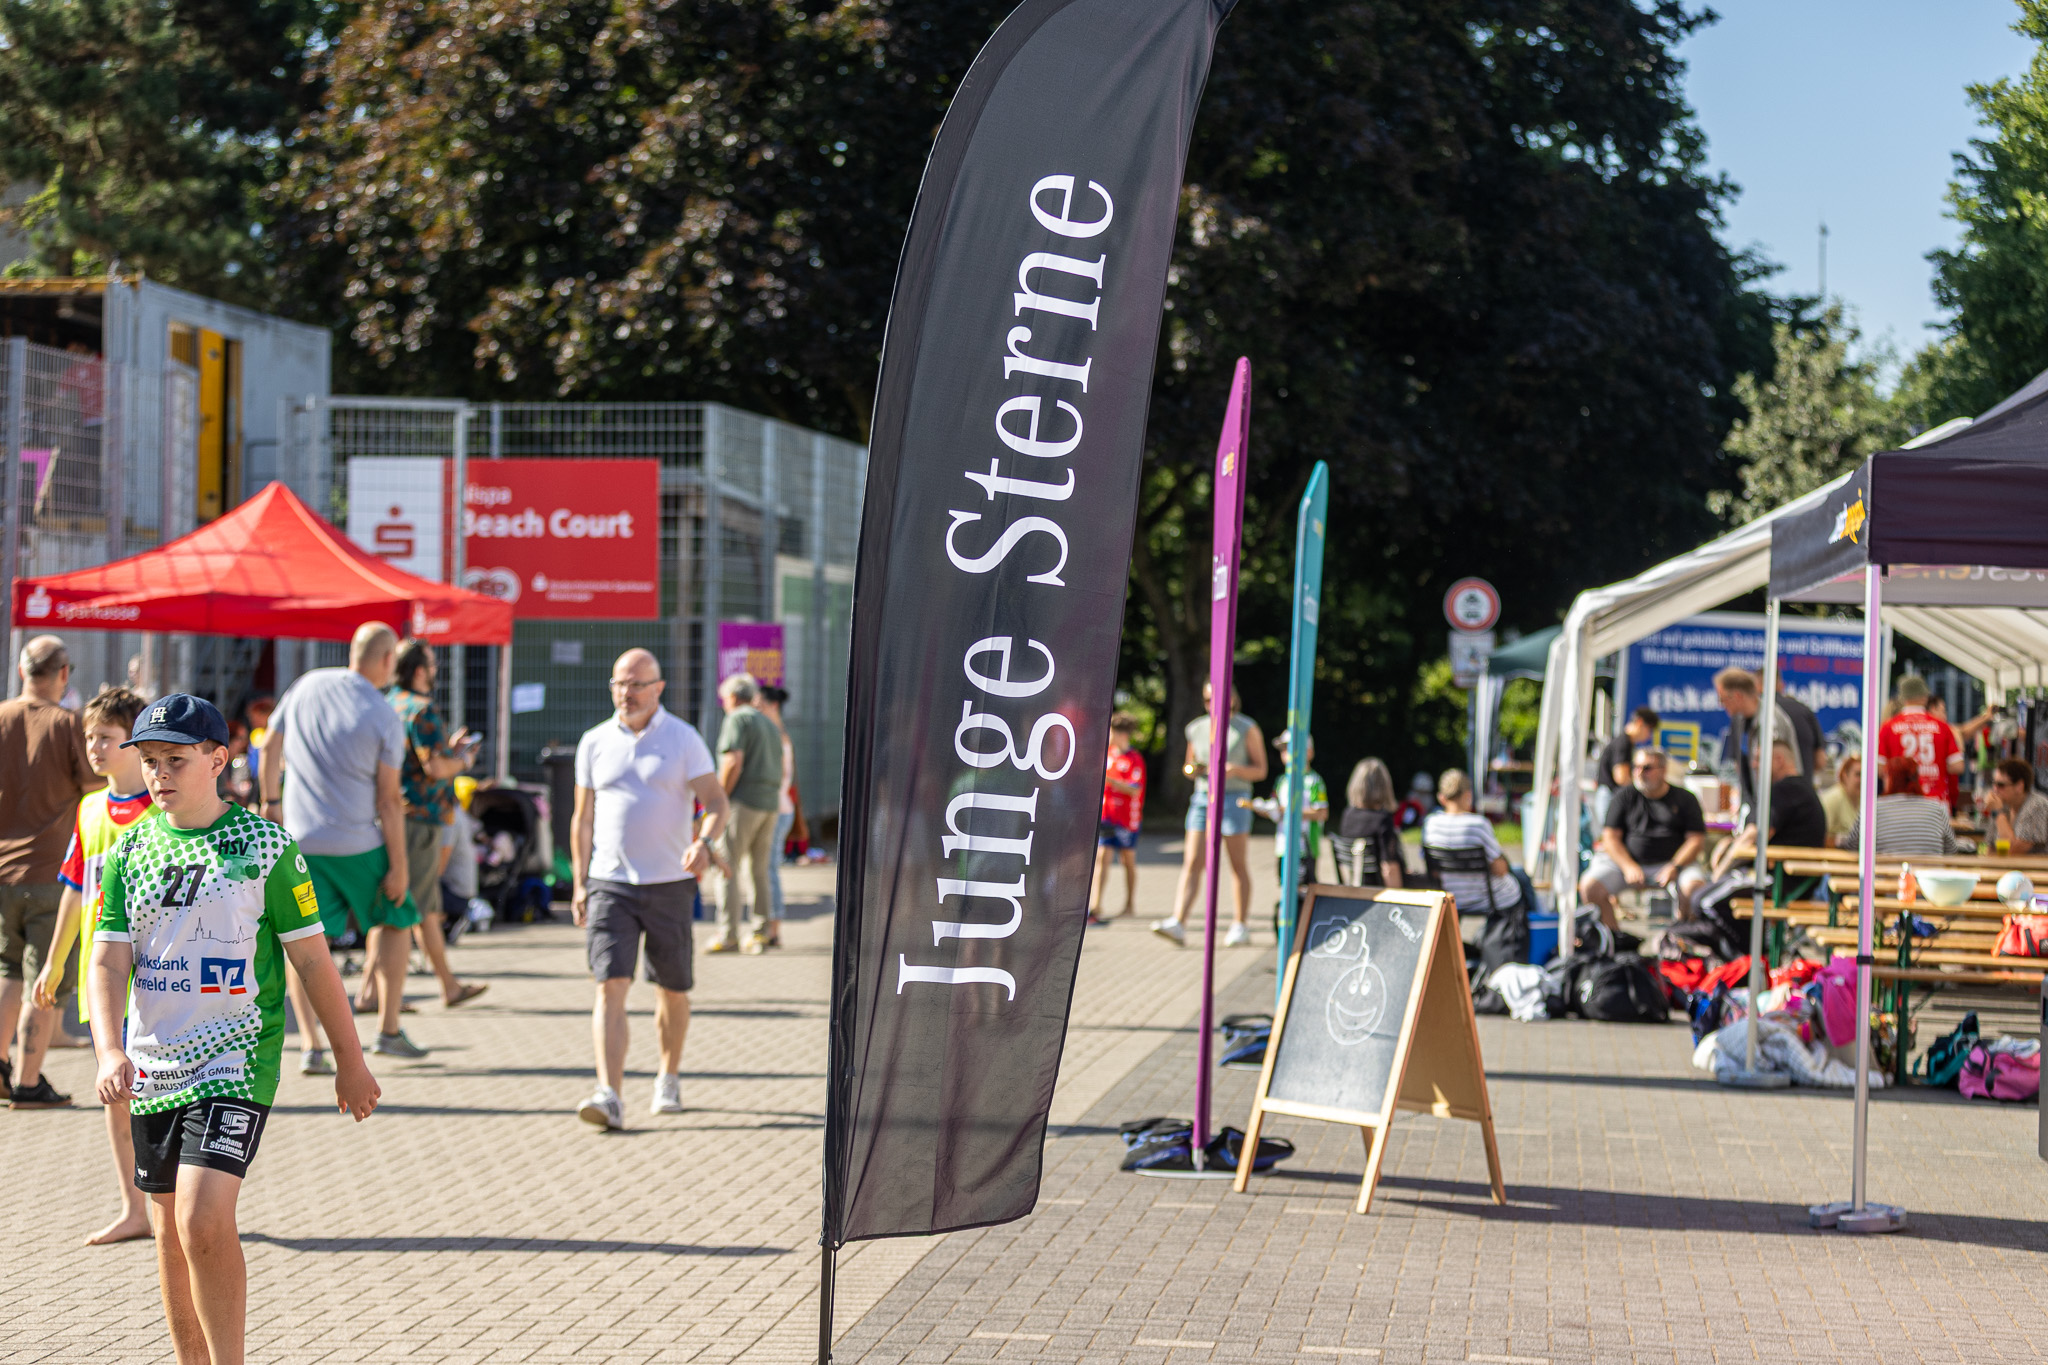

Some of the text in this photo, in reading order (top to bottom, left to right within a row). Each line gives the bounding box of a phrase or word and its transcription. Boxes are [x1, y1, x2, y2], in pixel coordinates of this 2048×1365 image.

[463, 507, 634, 538] Beach Court
[896, 172, 1115, 1000] Junge Sterne
[217, 839, 250, 857] HSV
[161, 864, 207, 907] 27
[171, 978, 192, 993] eG
[153, 1066, 240, 1092] BAUSYSTEME GMBH
[216, 1135, 243, 1149] Johann
